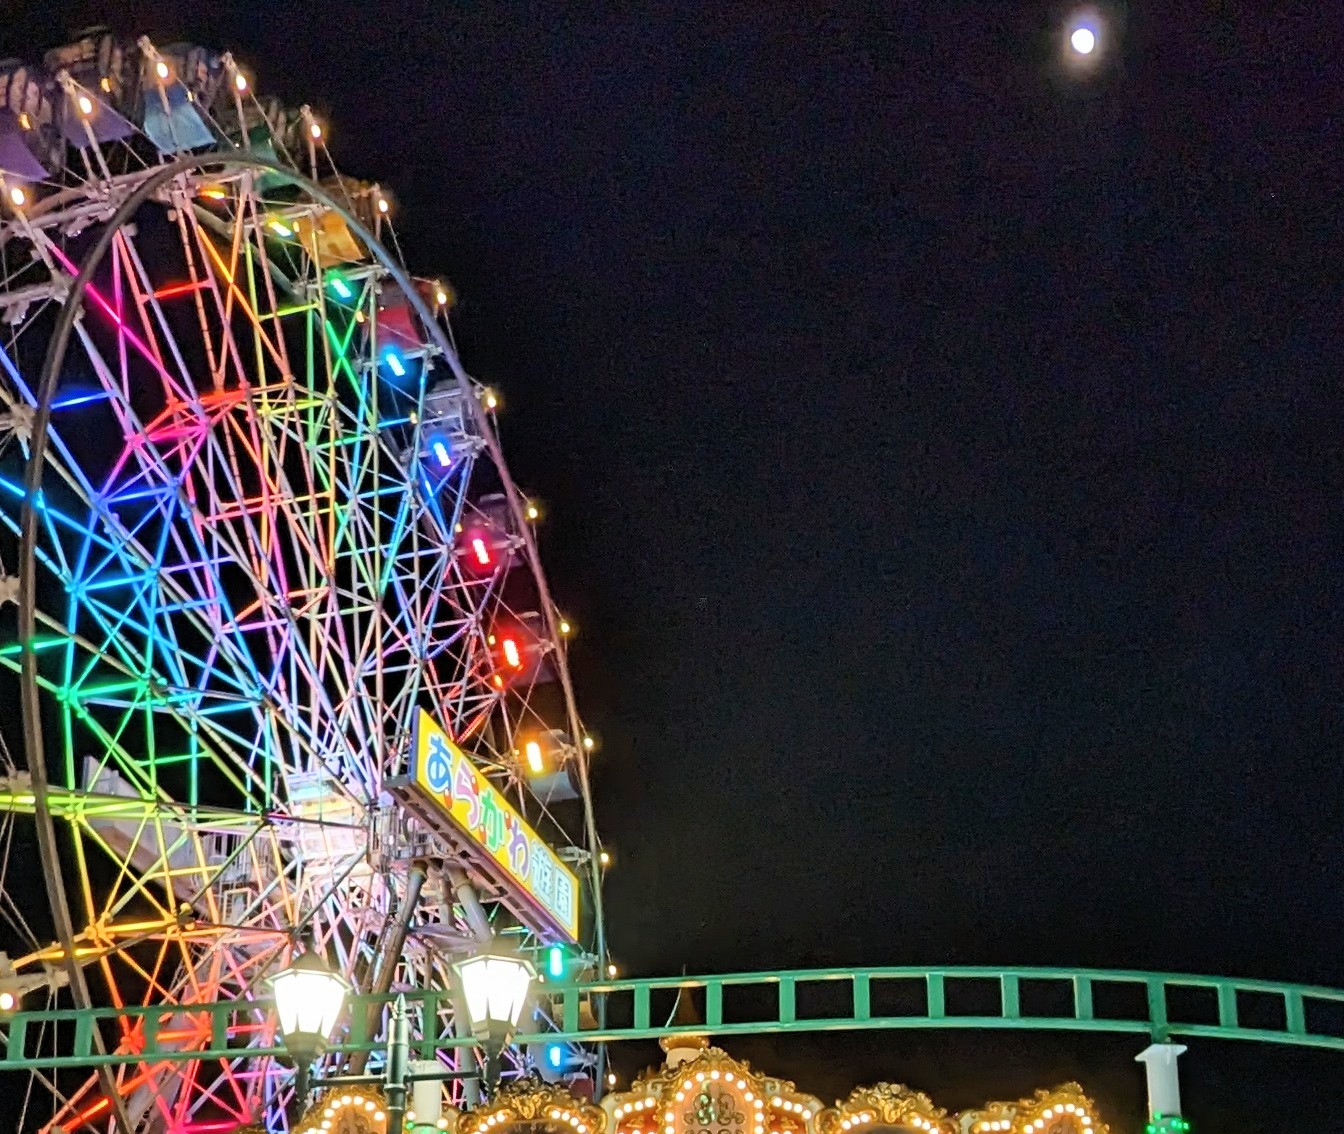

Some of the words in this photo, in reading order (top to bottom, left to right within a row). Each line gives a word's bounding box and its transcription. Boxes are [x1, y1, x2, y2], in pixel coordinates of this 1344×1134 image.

[426, 733, 573, 930] あらかわ遊園
